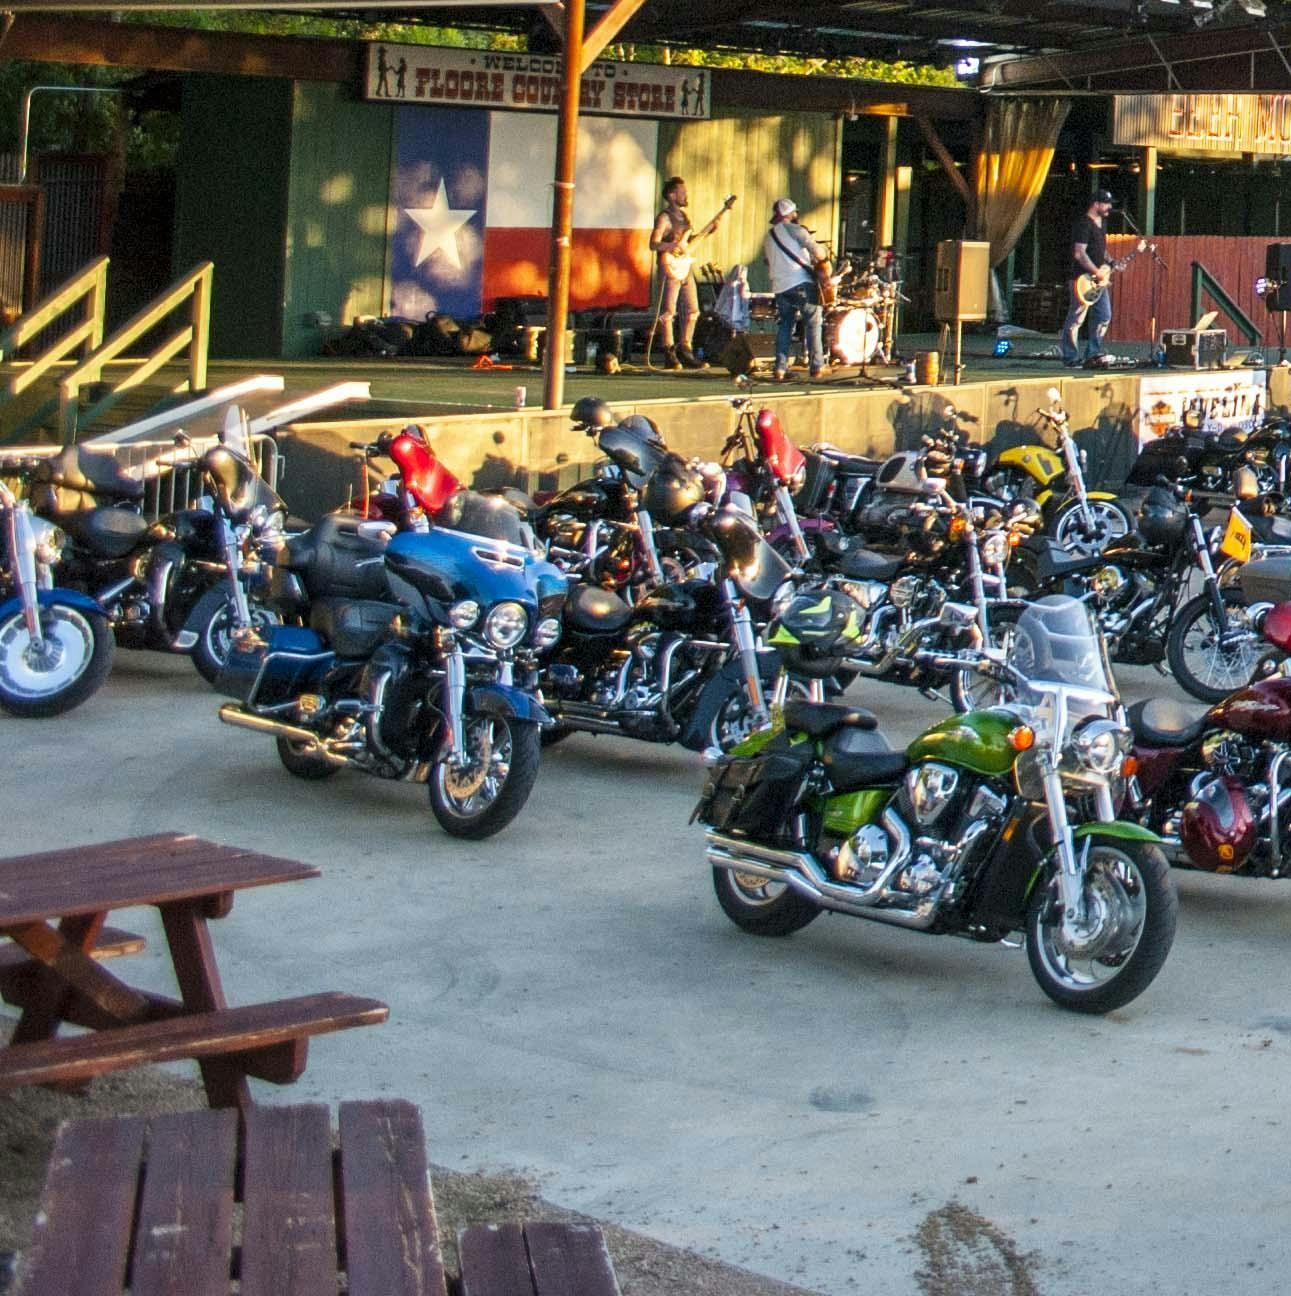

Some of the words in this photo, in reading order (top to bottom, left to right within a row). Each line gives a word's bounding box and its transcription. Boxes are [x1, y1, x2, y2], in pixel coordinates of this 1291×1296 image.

[484, 56, 564, 75] WELCO
[595, 63, 617, 79] TO
[415, 66, 505, 102] FLOORE
[512, 73, 606, 109] COUNRY
[613, 80, 677, 113] STORE
